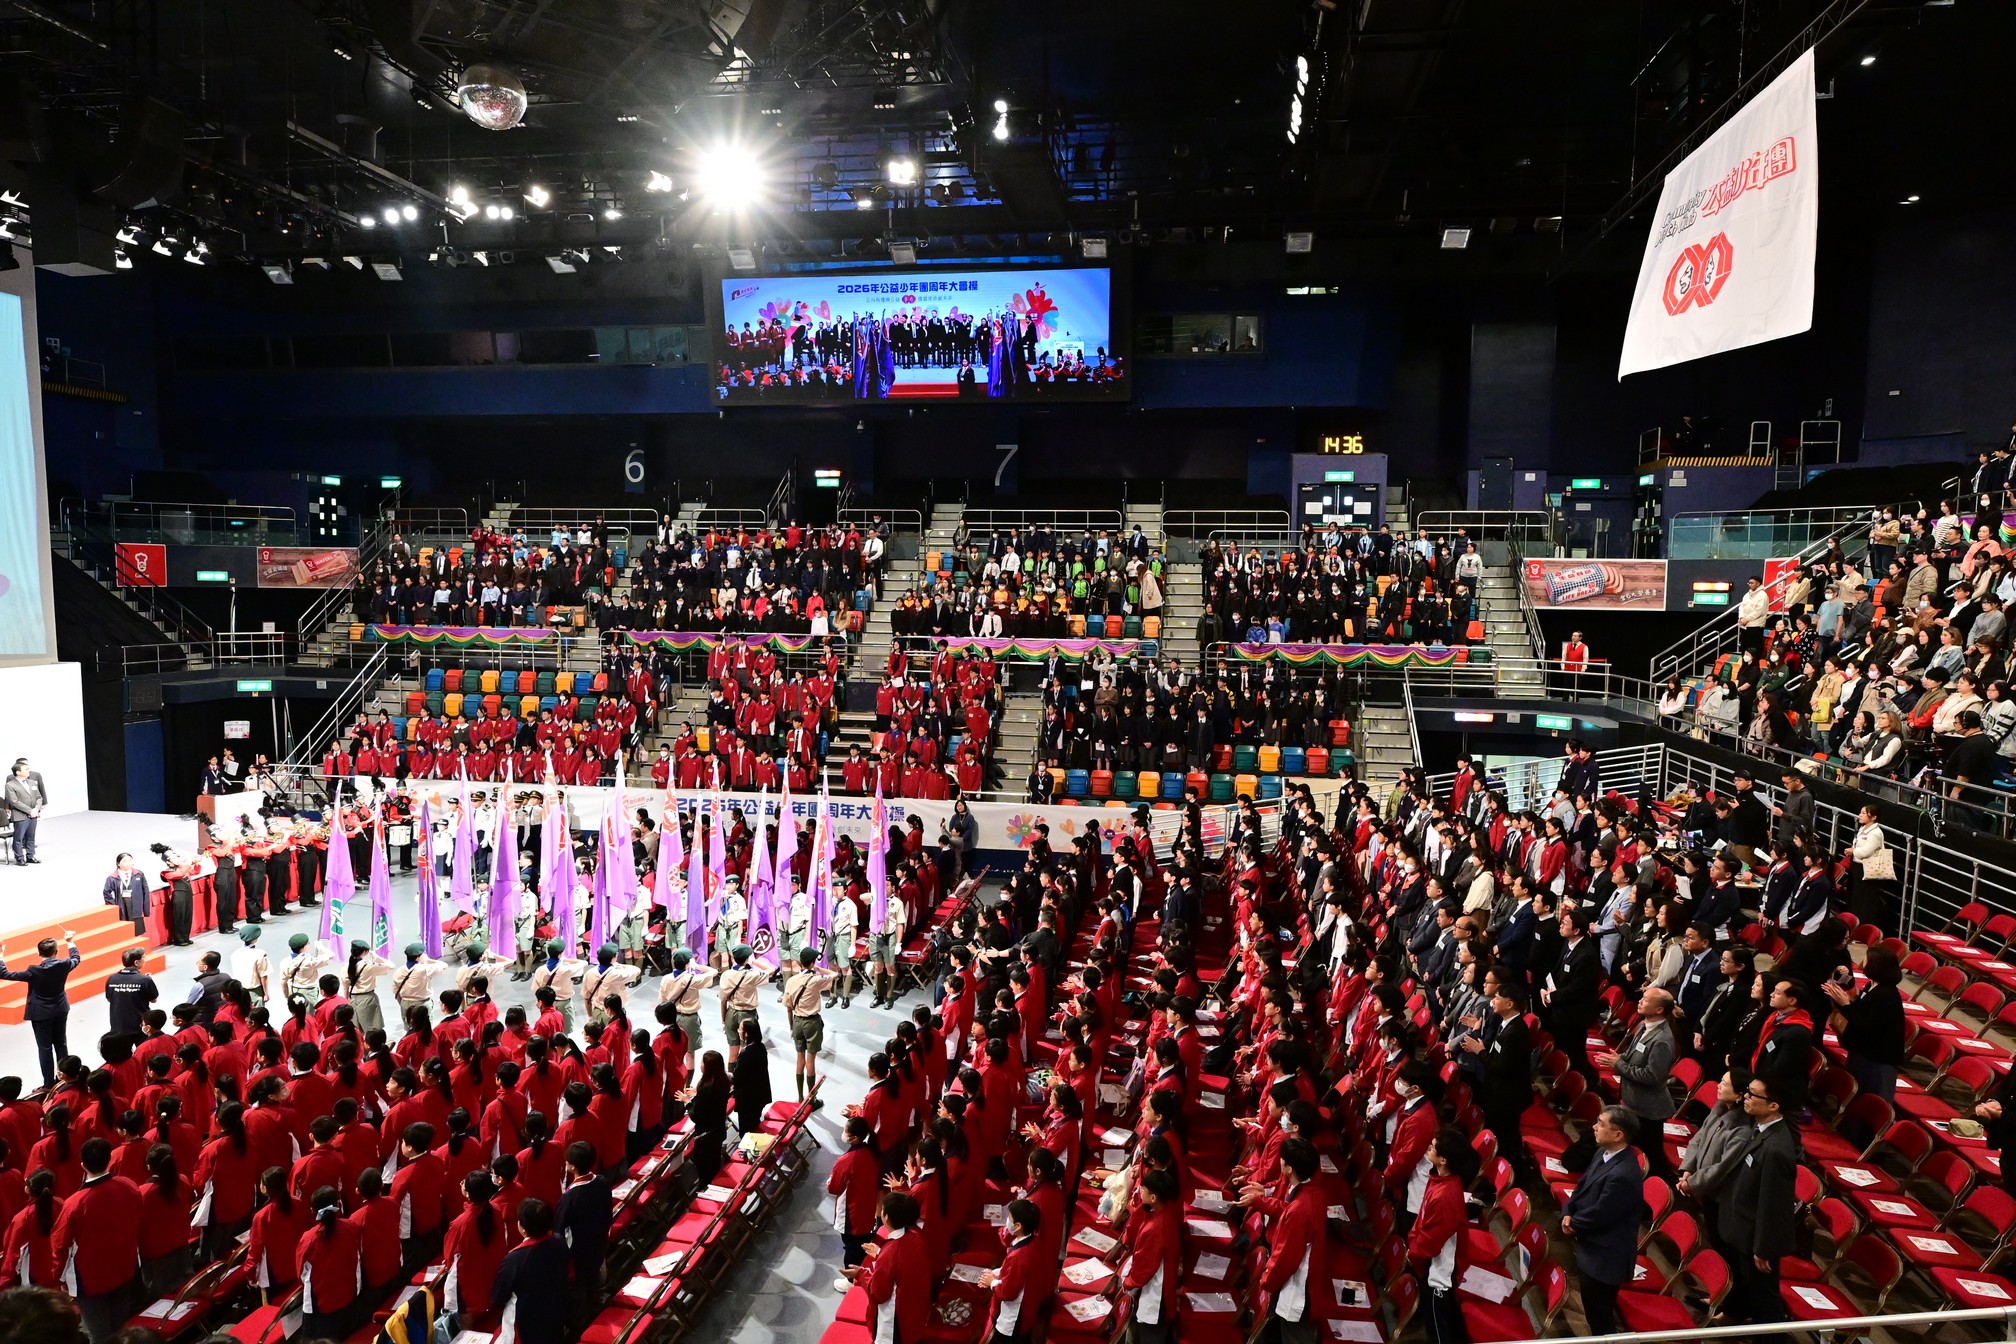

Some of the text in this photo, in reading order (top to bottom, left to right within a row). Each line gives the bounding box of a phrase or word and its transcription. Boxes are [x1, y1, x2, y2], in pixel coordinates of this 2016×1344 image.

[1702, 136, 1797, 218] 公益少年團
[837, 280, 979, 294] 2026年公益少年團周年大會操
[1325, 435, 1364, 454] 14 36
[624, 449, 645, 483] 6
[994, 443, 1019, 488] 7
[1562, 588, 1596, 601] LIFE BREAD
